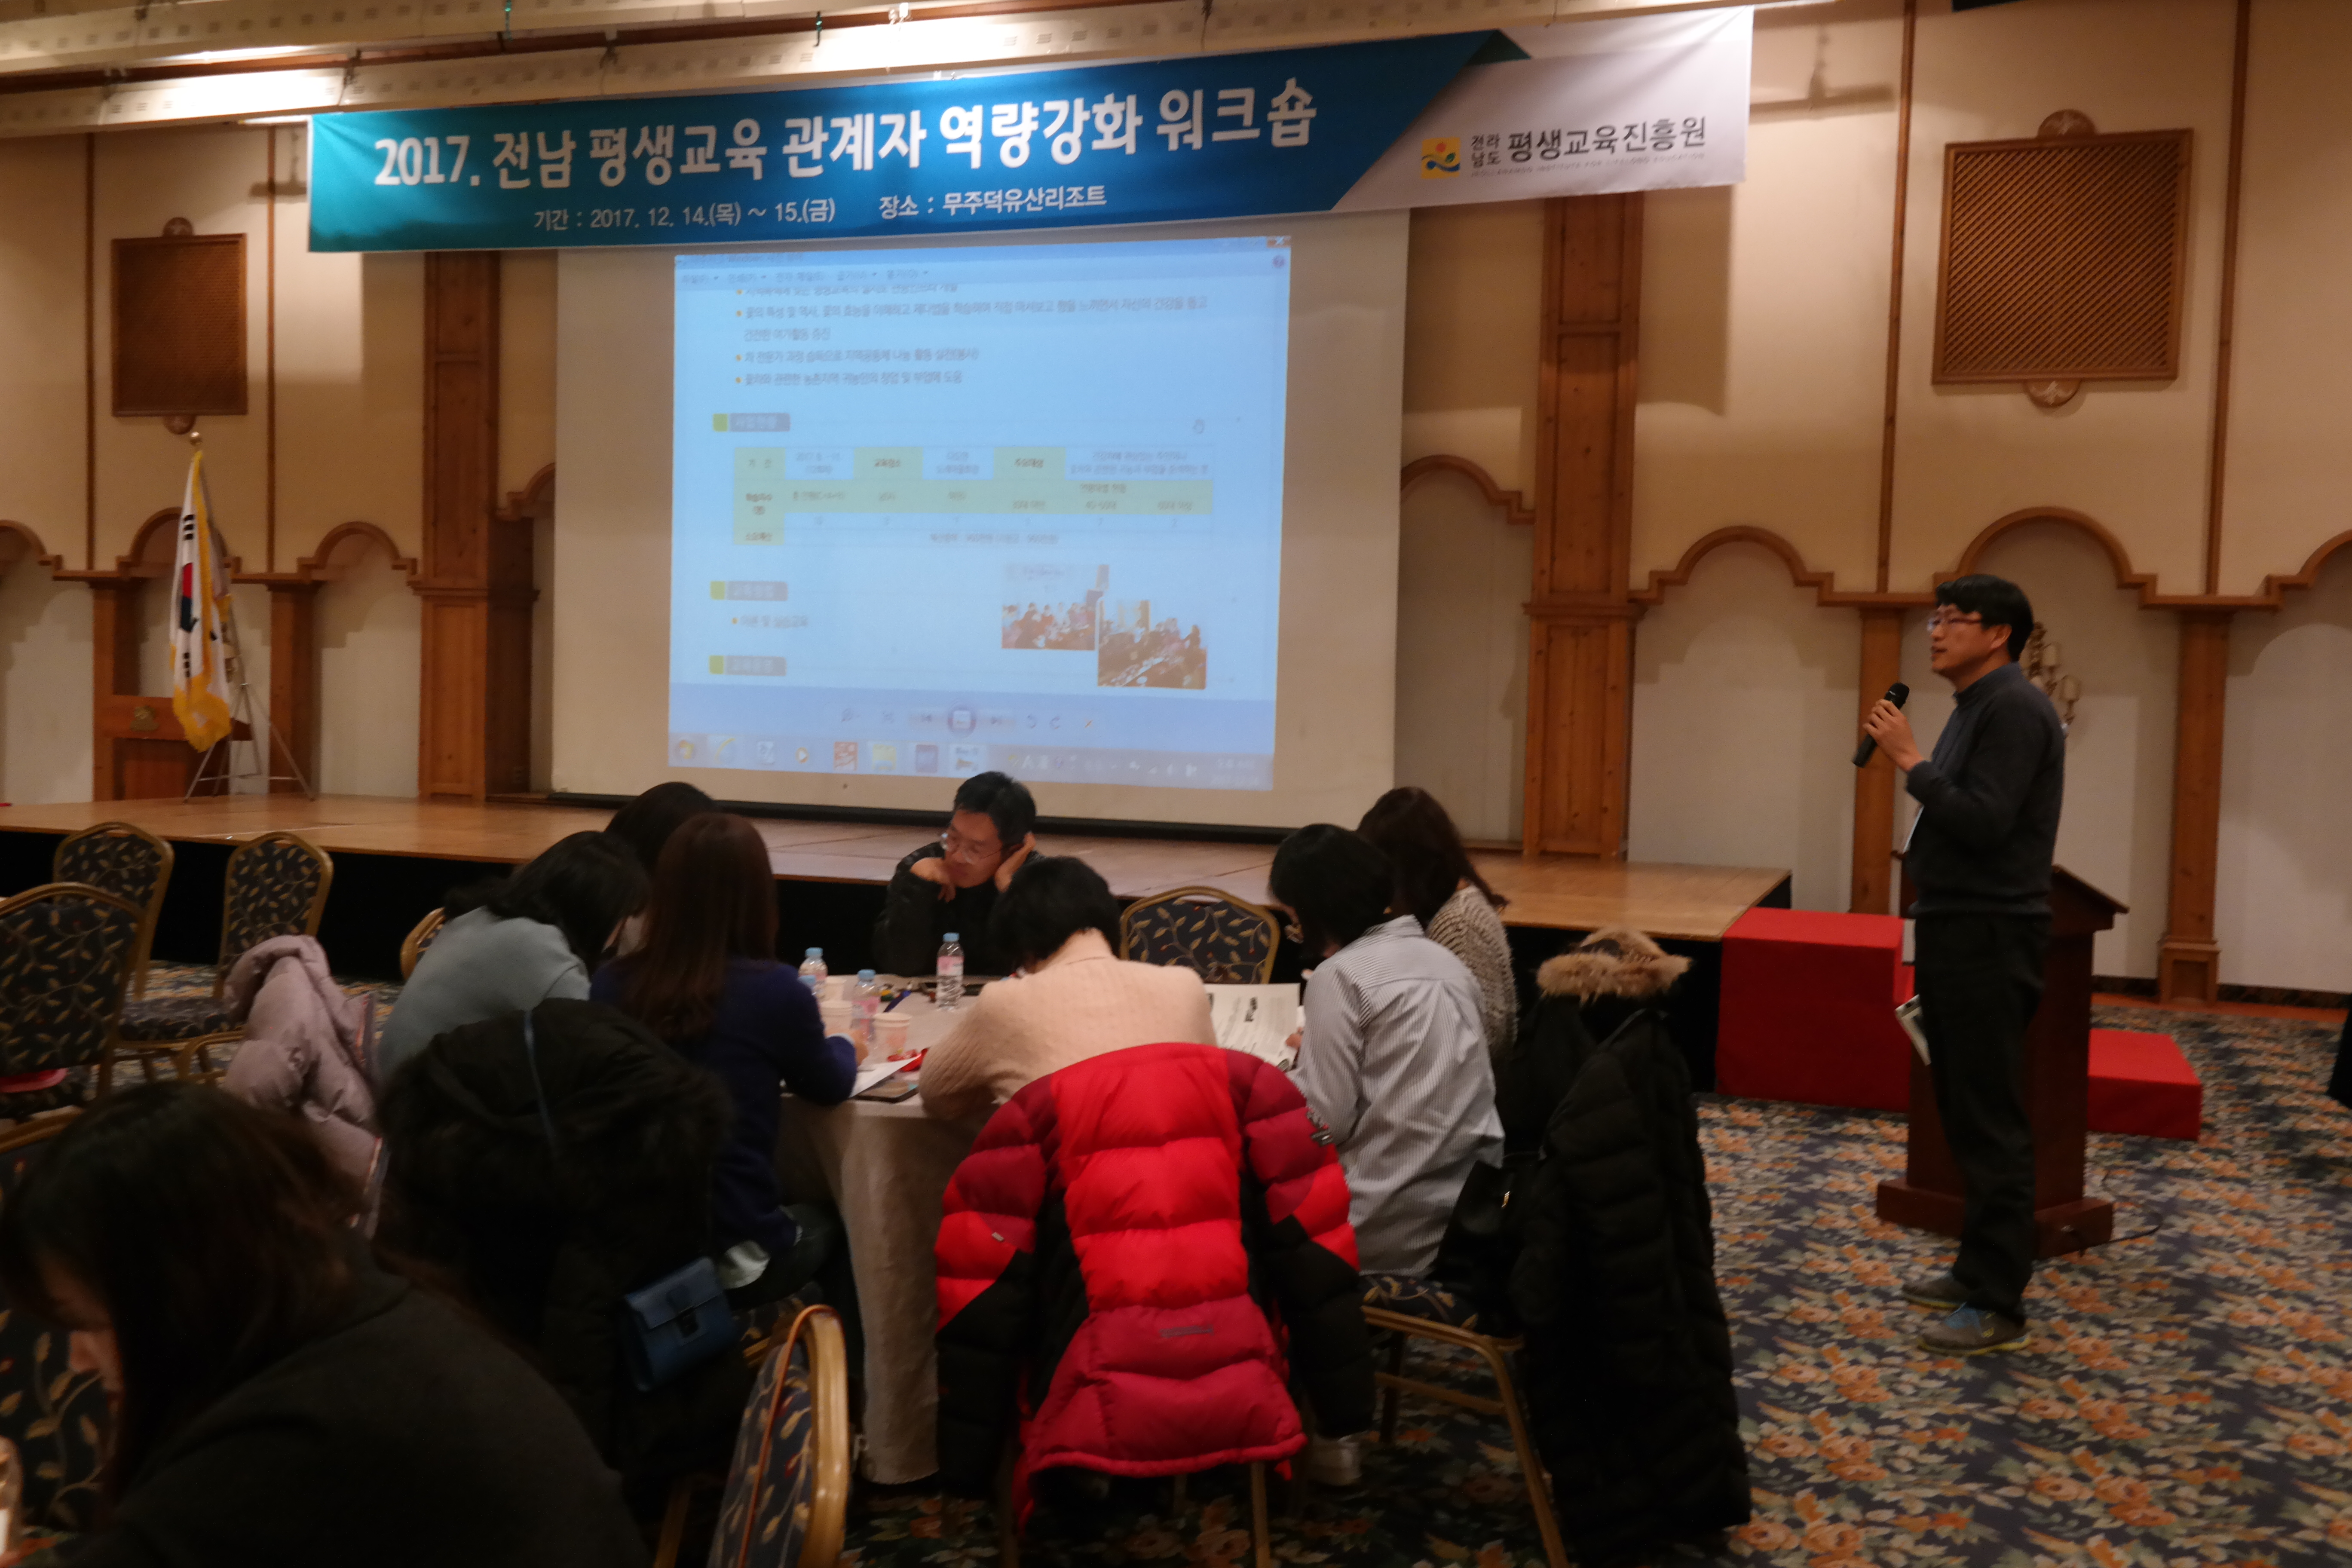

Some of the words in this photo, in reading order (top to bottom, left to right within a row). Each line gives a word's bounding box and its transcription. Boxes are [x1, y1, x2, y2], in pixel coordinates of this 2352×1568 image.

[374, 135, 480, 187] 2017.
[492, 129, 576, 190] 전남
[590, 118, 768, 187] 평생교육
[782, 109, 928, 178] 관계자
[939, 92, 1142, 169] 역량강화
[1156, 77, 1317, 151] 워크숍
[1471, 134, 1501, 150] 전라
[1507, 116, 1706, 162] 평생교육진흥원
[1471, 151, 1501, 168] 남도
[534, 208, 570, 232] 기간
[590, 208, 640, 229] 2017.
[648, 206, 674, 227] 12.
[683, 202, 741, 227] 14.(목)
[775, 197, 836, 224] 15.(금)
[879, 194, 919, 220] 장소
[942, 185, 1107, 216] 무주덕유산리조트
